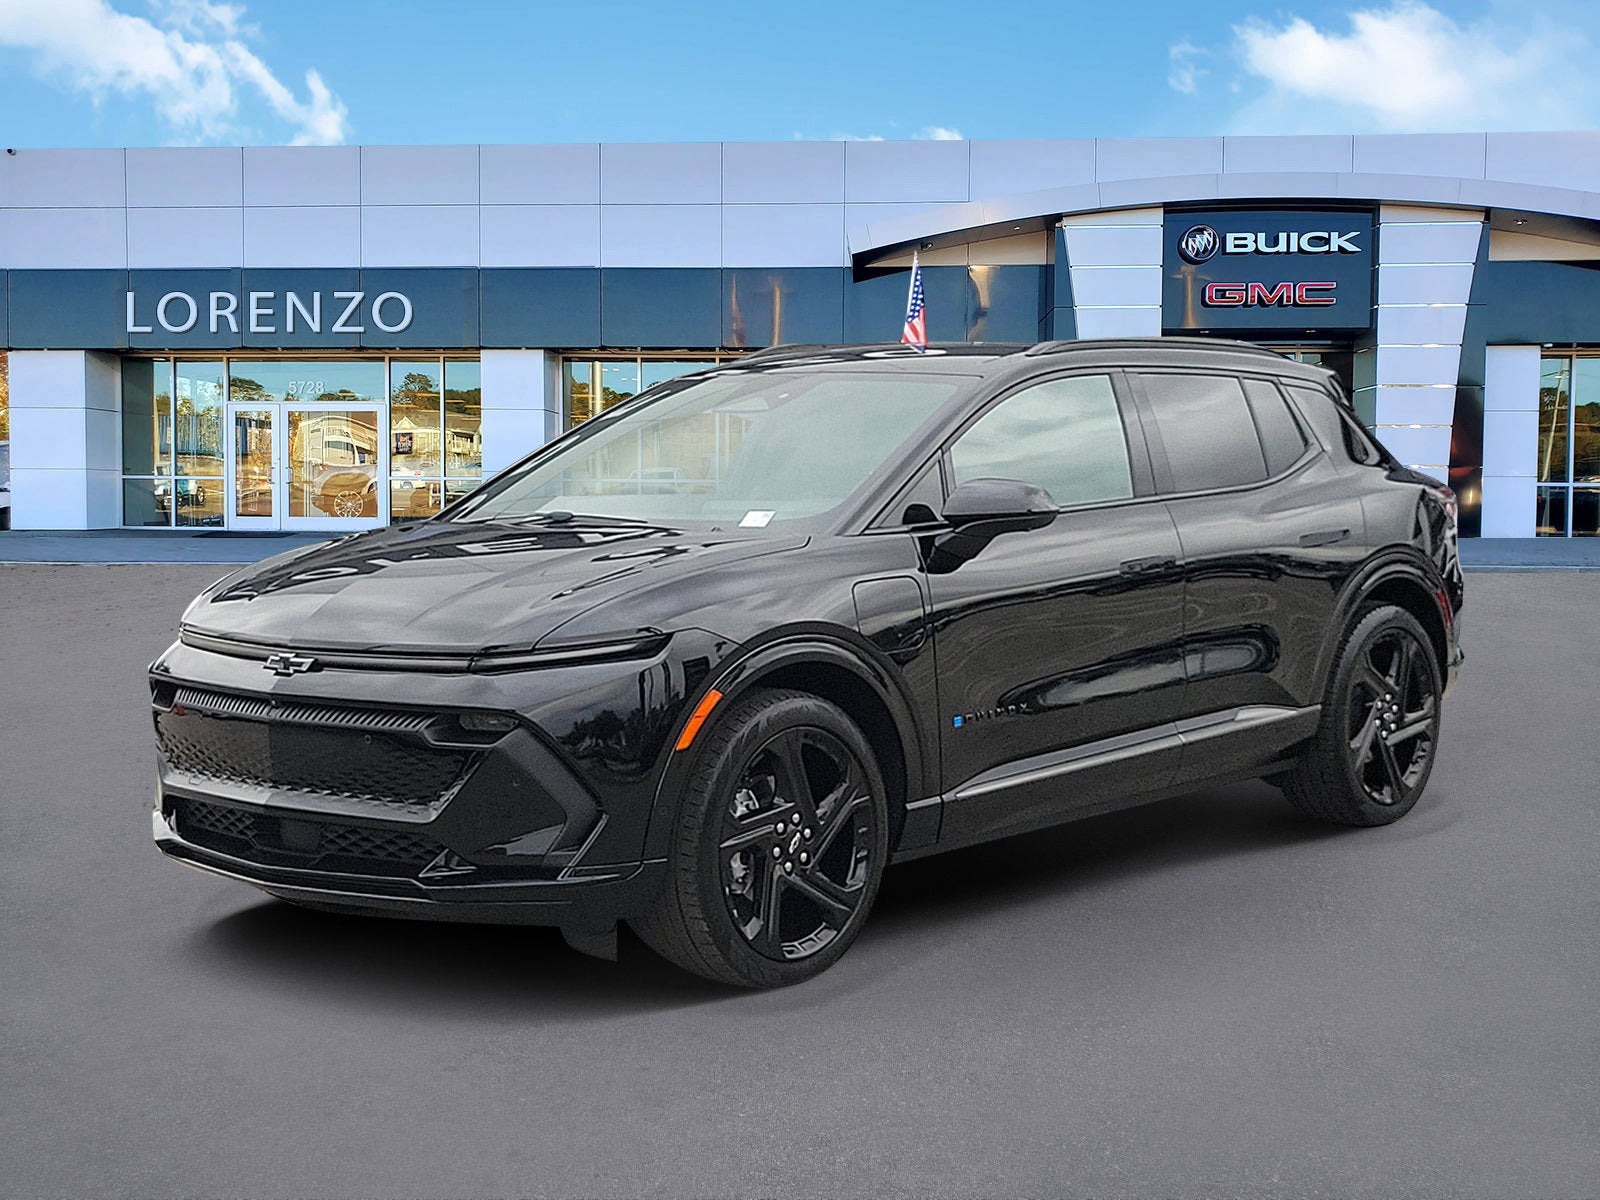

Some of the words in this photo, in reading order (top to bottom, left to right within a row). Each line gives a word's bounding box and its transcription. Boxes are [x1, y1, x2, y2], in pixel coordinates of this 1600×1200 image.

[1225, 231, 1362, 253] BUICK
[1205, 282, 1336, 305] GMC
[126, 291, 413, 333] LORENZO
[288, 381, 325, 394] 5728
